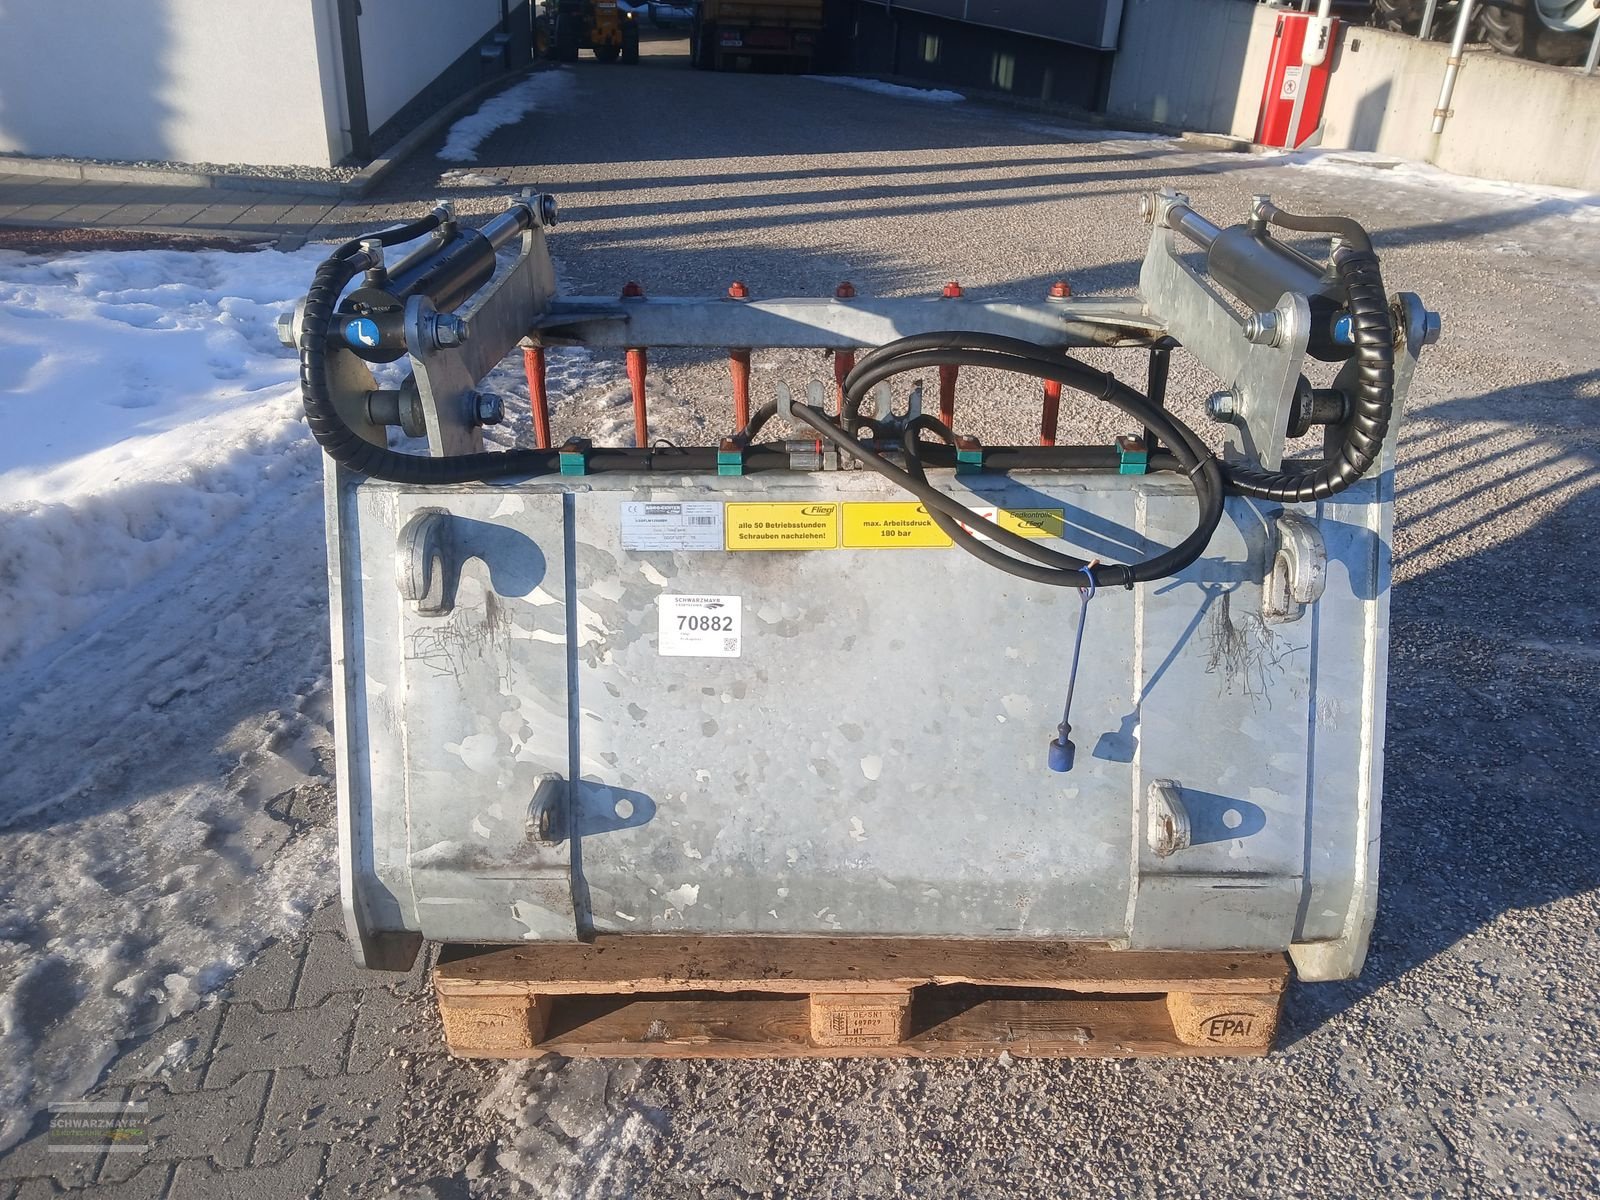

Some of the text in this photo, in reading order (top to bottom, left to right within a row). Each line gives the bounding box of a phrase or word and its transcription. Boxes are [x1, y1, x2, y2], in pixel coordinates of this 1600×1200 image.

[810, 505, 835, 516] Fliegl
[765, 521, 827, 529] Betriebsstunden
[883, 519, 932, 527] Arbeitsdruck
[739, 532, 826, 540] Schrauben nachziehen!
[881, 529, 912, 537] 180 bar
[676, 615, 733, 632] 70882
